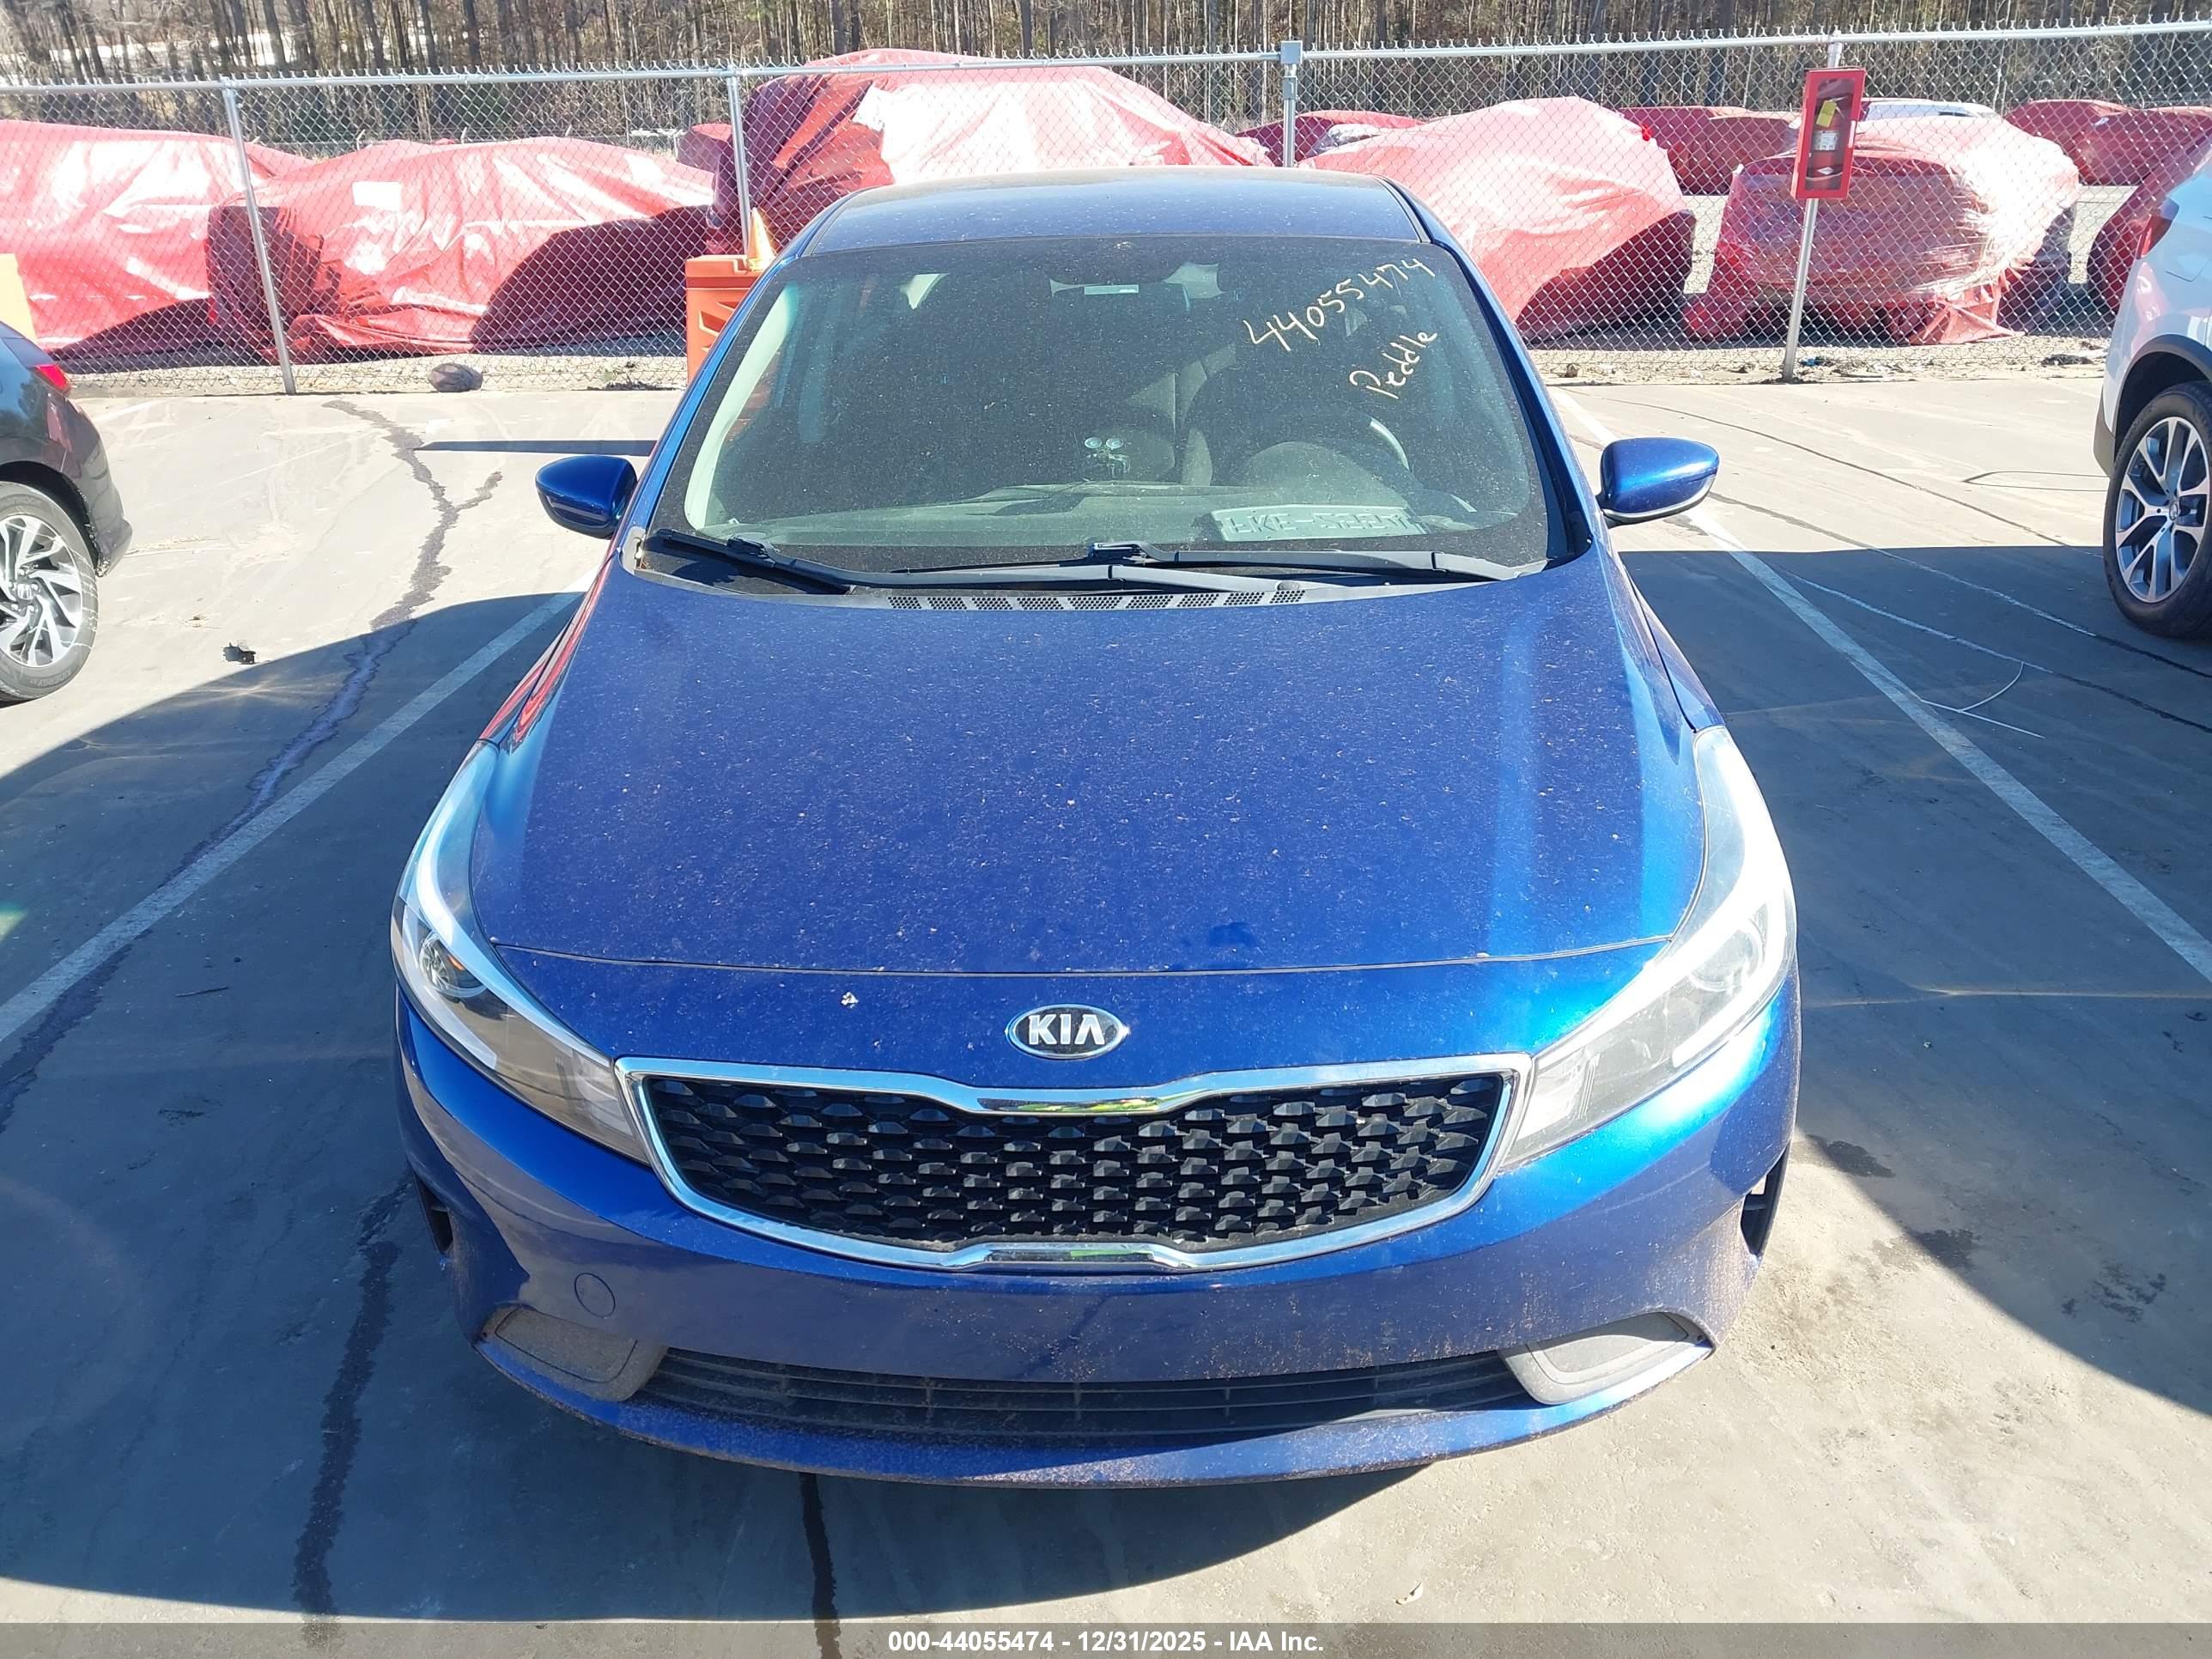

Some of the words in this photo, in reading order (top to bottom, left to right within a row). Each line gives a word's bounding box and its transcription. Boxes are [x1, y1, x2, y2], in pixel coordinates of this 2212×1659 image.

[1243, 258, 1436, 351] 44055474
[1349, 331, 1438, 399] Peddle
[1029, 1013, 1105, 1045] KIA
